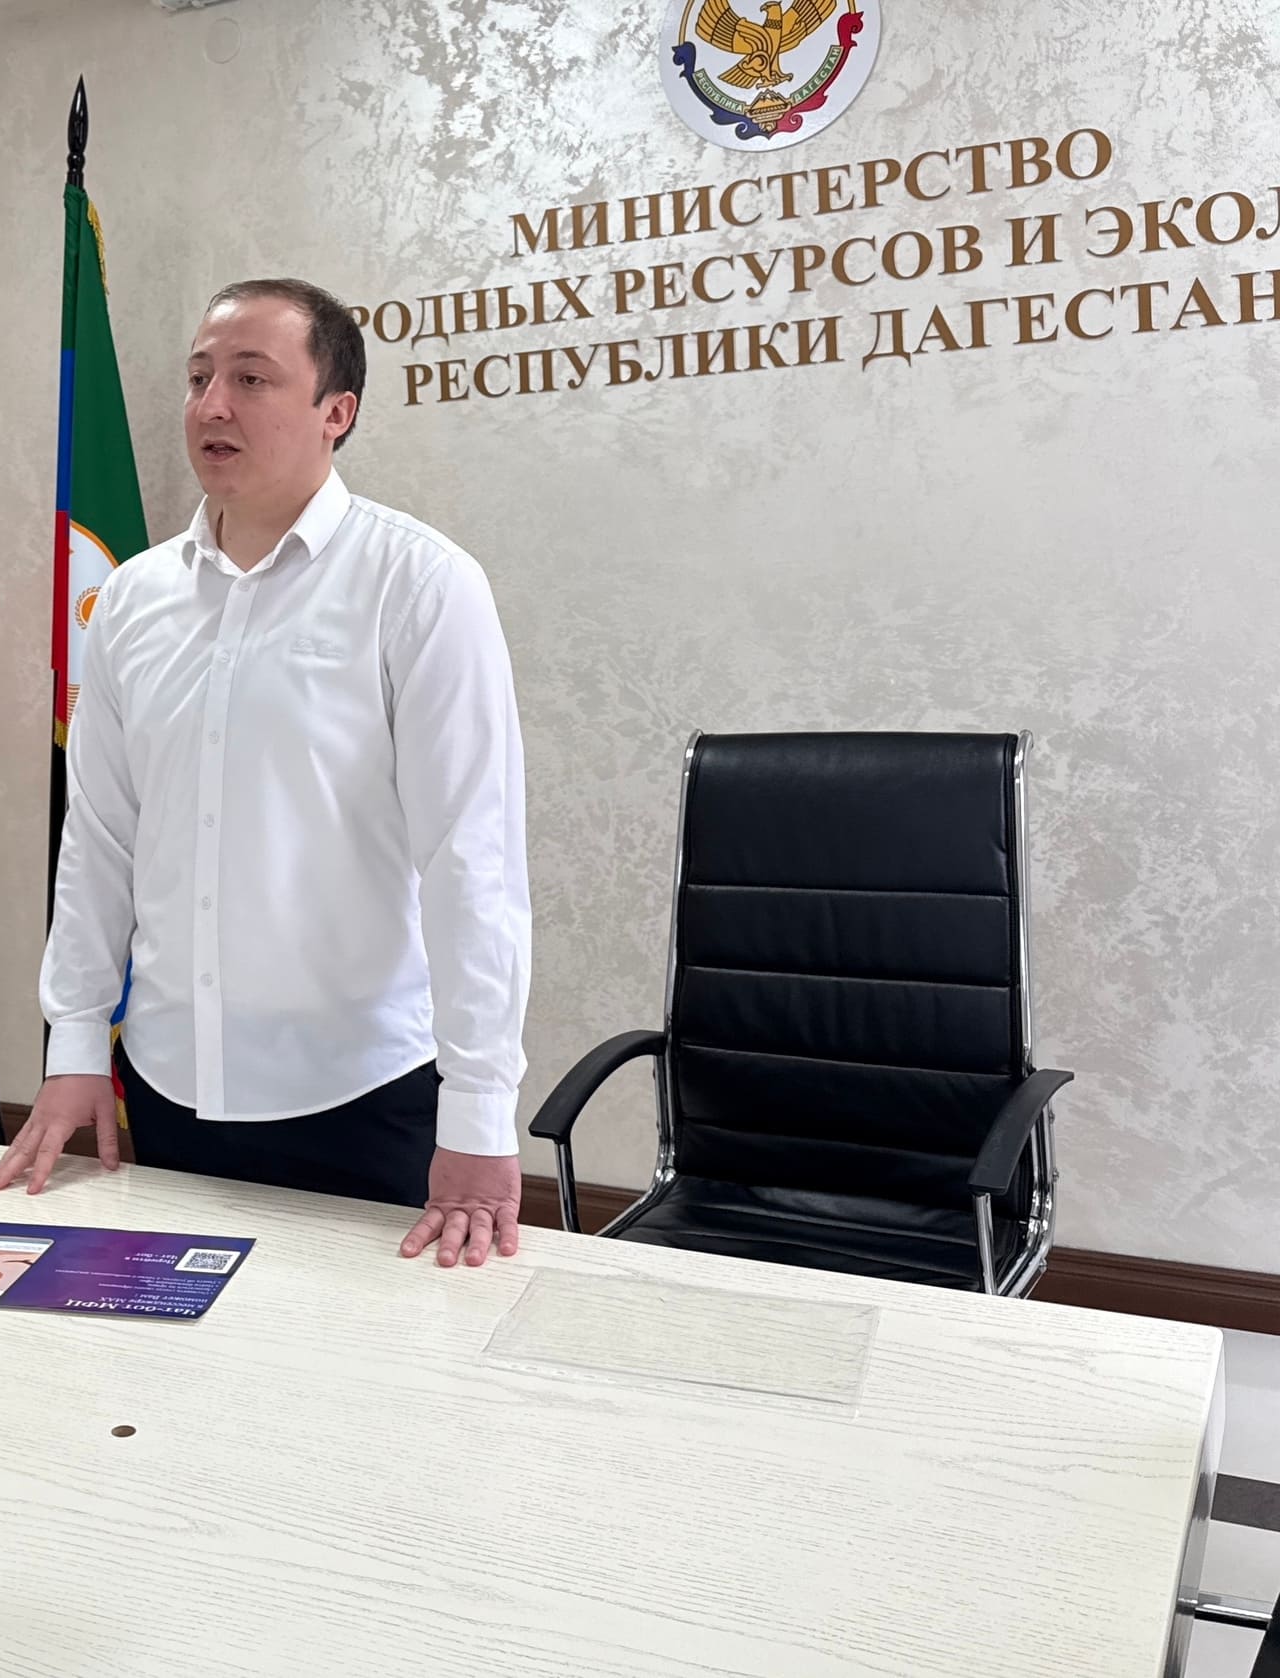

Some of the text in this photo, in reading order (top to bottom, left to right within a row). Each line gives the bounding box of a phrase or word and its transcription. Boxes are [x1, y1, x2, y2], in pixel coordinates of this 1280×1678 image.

[695, 47, 841, 112] РЕСПУБЛИКА ДАГЕСТАН
[510, 128, 1113, 258] МИНИСТЕРСТВО
[614, 223, 984, 315] РЕСУРСОВ
[1005, 214, 1063, 268] И
[401, 314, 843, 406] РЕСПУБЛИКИ
[64, 1299, 196, 1316] Чат-бот МФЦ
